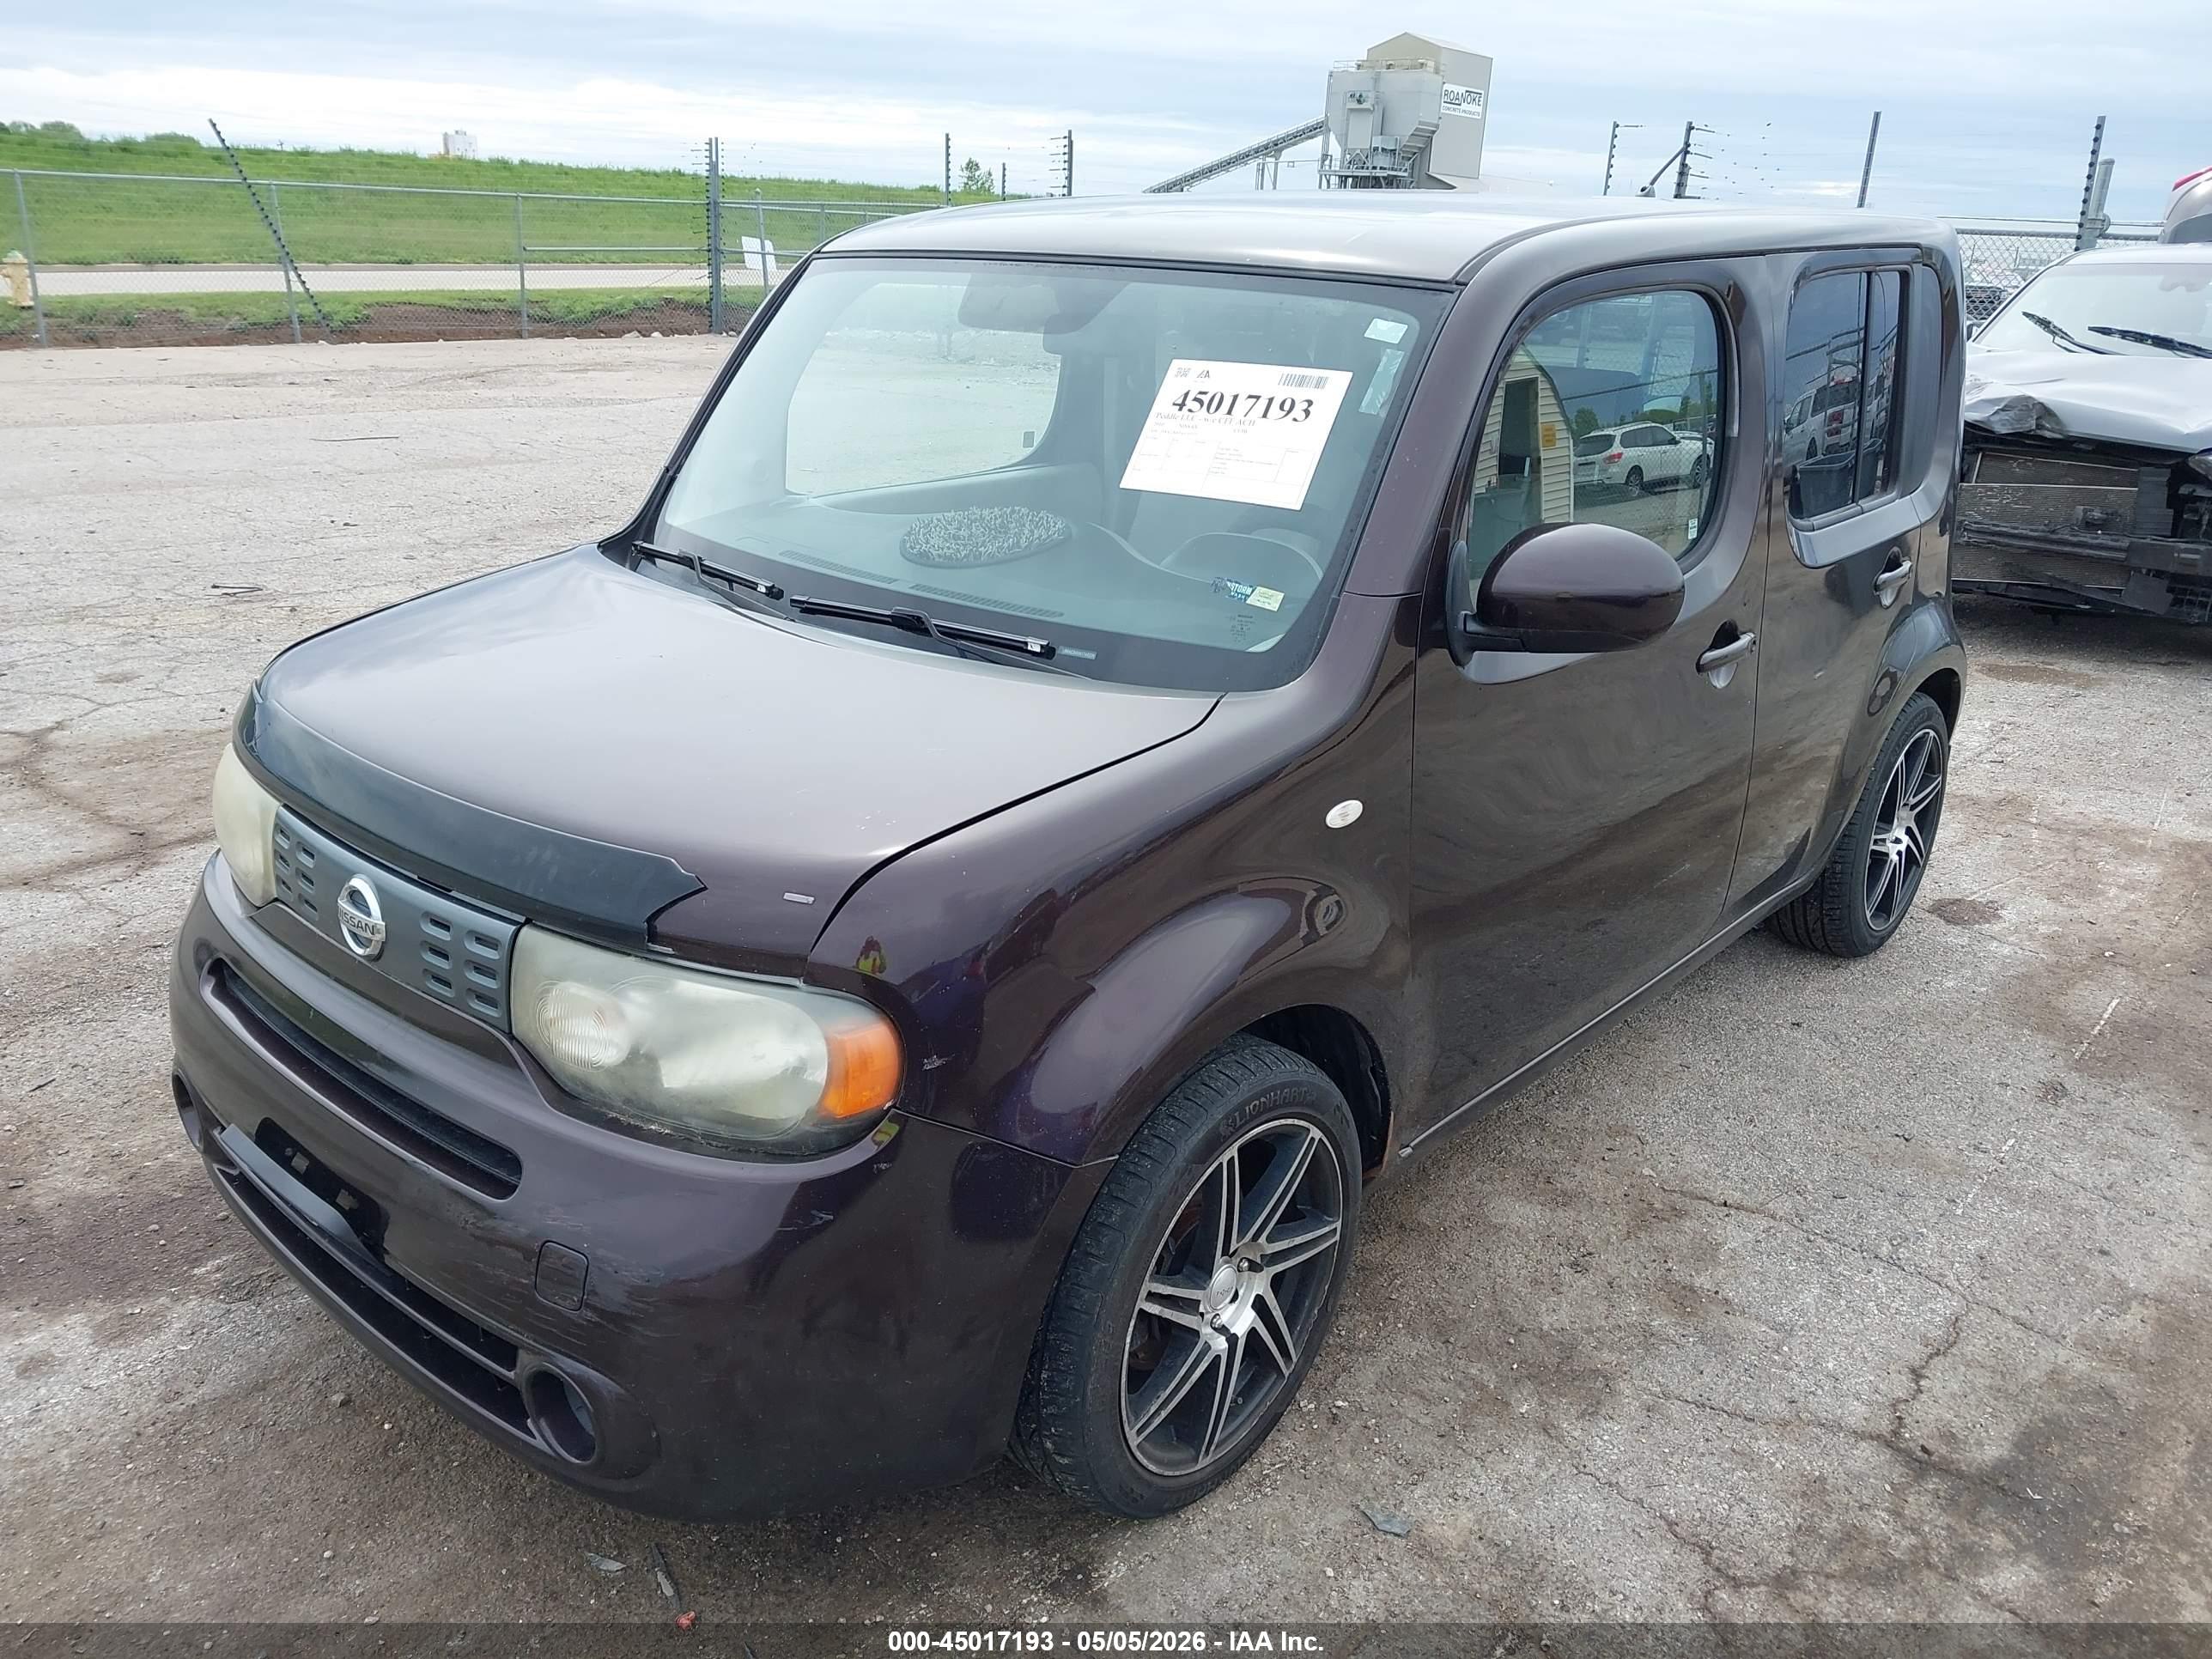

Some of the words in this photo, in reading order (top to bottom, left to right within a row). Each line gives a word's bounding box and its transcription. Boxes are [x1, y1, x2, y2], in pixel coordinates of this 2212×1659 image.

[1443, 89, 1482, 106] ROANOKE
[1172, 389, 1314, 422] 45017193
[1234, 1086, 1309, 1128] LIONHART
